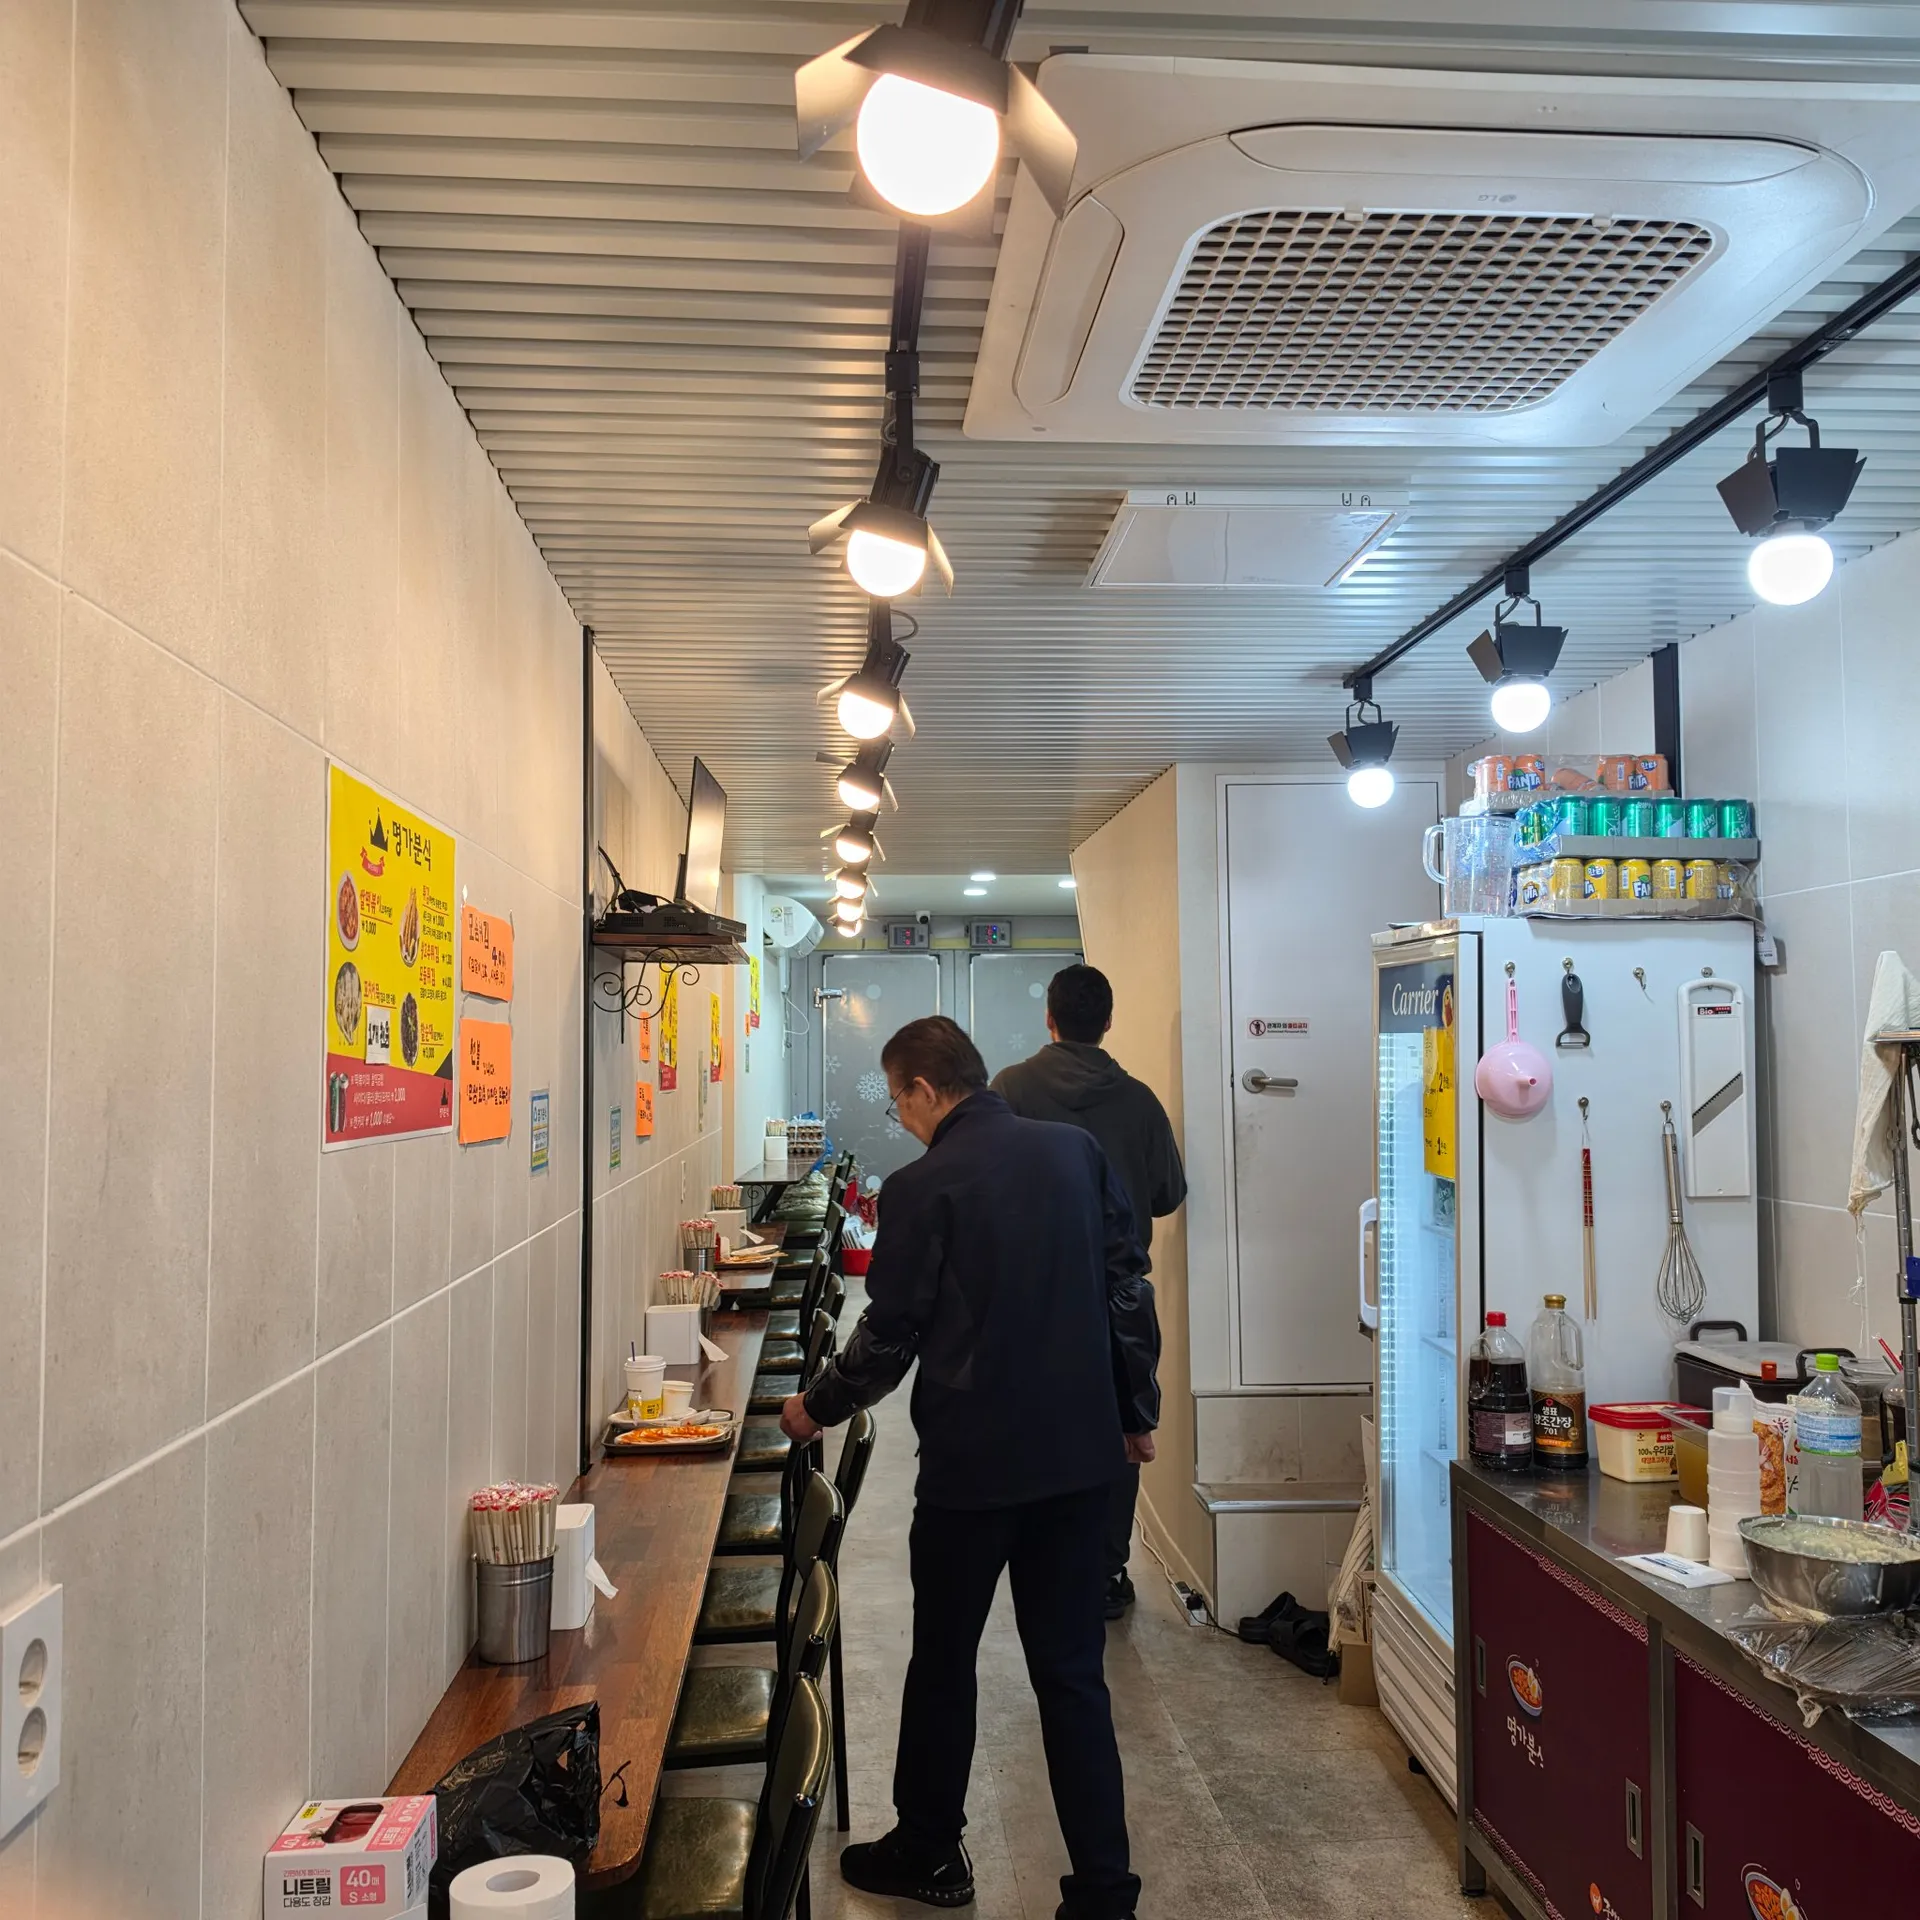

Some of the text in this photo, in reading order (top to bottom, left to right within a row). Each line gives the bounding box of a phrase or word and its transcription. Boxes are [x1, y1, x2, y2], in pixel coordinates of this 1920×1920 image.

[392, 820, 431, 871] 명가분식
[1392, 983, 1439, 1016] Carrier
[1699, 1007, 1713, 1015] Bio
[1542, 1406, 1558, 1416] 샘표
[1533, 1413, 1572, 1429] 양조간장
[1544, 1427, 1558, 1435] 701
[1653, 1444, 1674, 1456] 우리쌀
[284, 1877, 331, 1896] 니트릴
[284, 1896, 331, 1908] 다용도 장갑
[349, 1891, 377, 1903] S 소형
